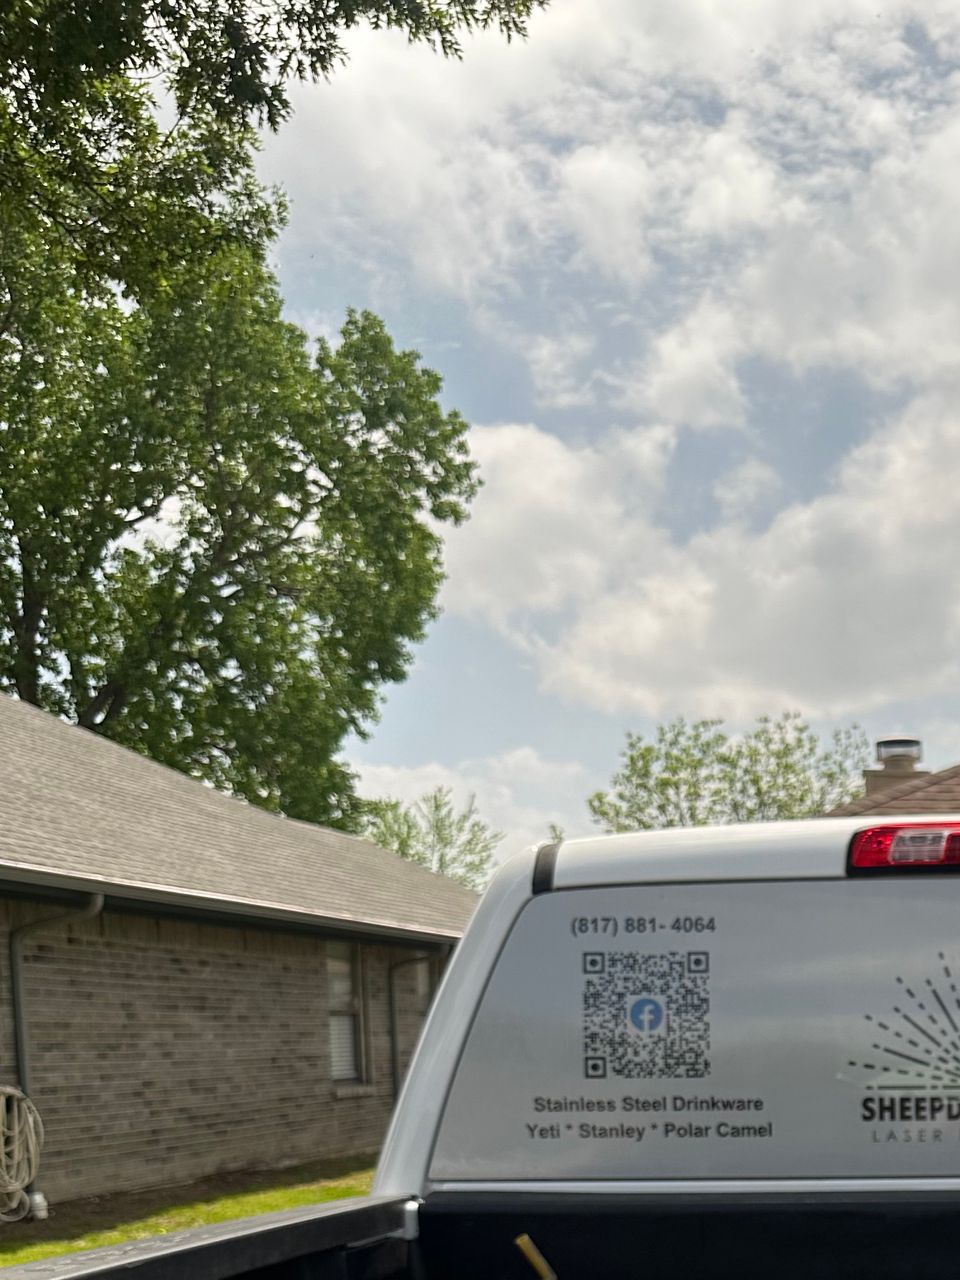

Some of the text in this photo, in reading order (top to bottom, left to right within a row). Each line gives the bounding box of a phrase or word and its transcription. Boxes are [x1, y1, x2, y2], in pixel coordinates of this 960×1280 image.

[571, 917, 618, 936] (817)
[671, 917, 717, 933] 4064
[534, 1095, 764, 1113] Stainless Steel Drinkware
[525, 1123, 561, 1139] Yeti
[577, 1123, 645, 1142] Stanley
[664, 1123, 710, 1138] Polar
[714, 1122, 773, 1137] Camel
[872, 1129, 943, 1143] LASER
